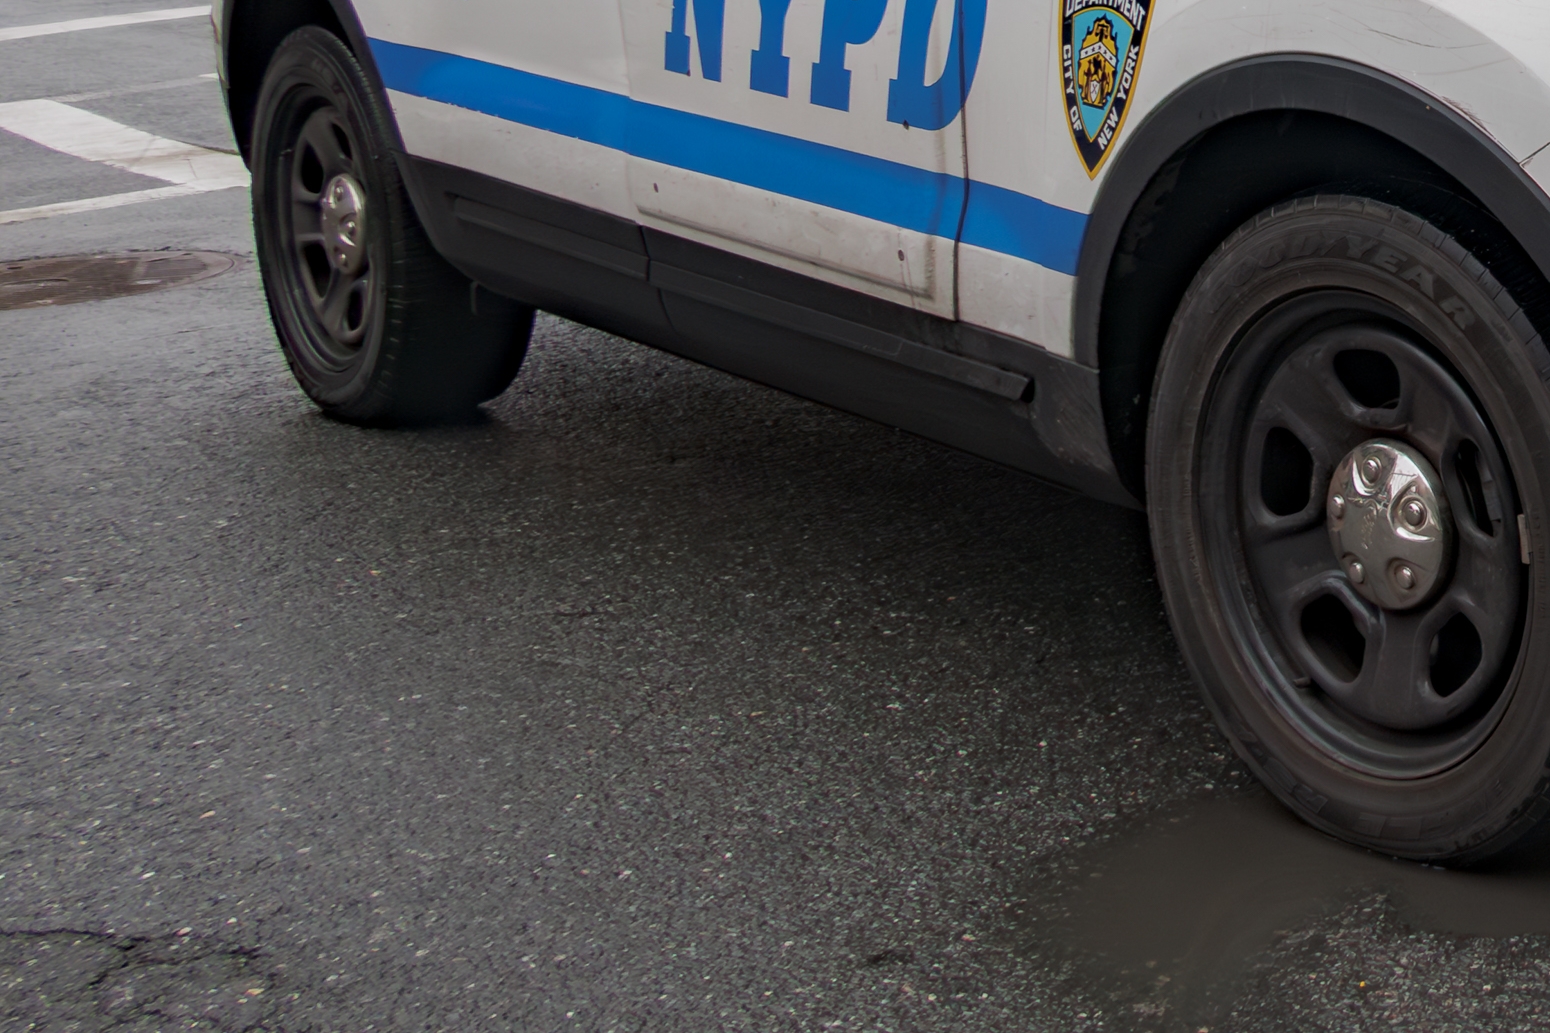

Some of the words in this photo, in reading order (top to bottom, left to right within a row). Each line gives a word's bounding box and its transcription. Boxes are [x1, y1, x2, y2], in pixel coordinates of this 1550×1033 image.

[1063, 44, 1075, 95] CITY
[1070, 105, 1083, 132] OF
[1097, 106, 1120, 151] NEW
[1116, 44, 1140, 100] YORK
